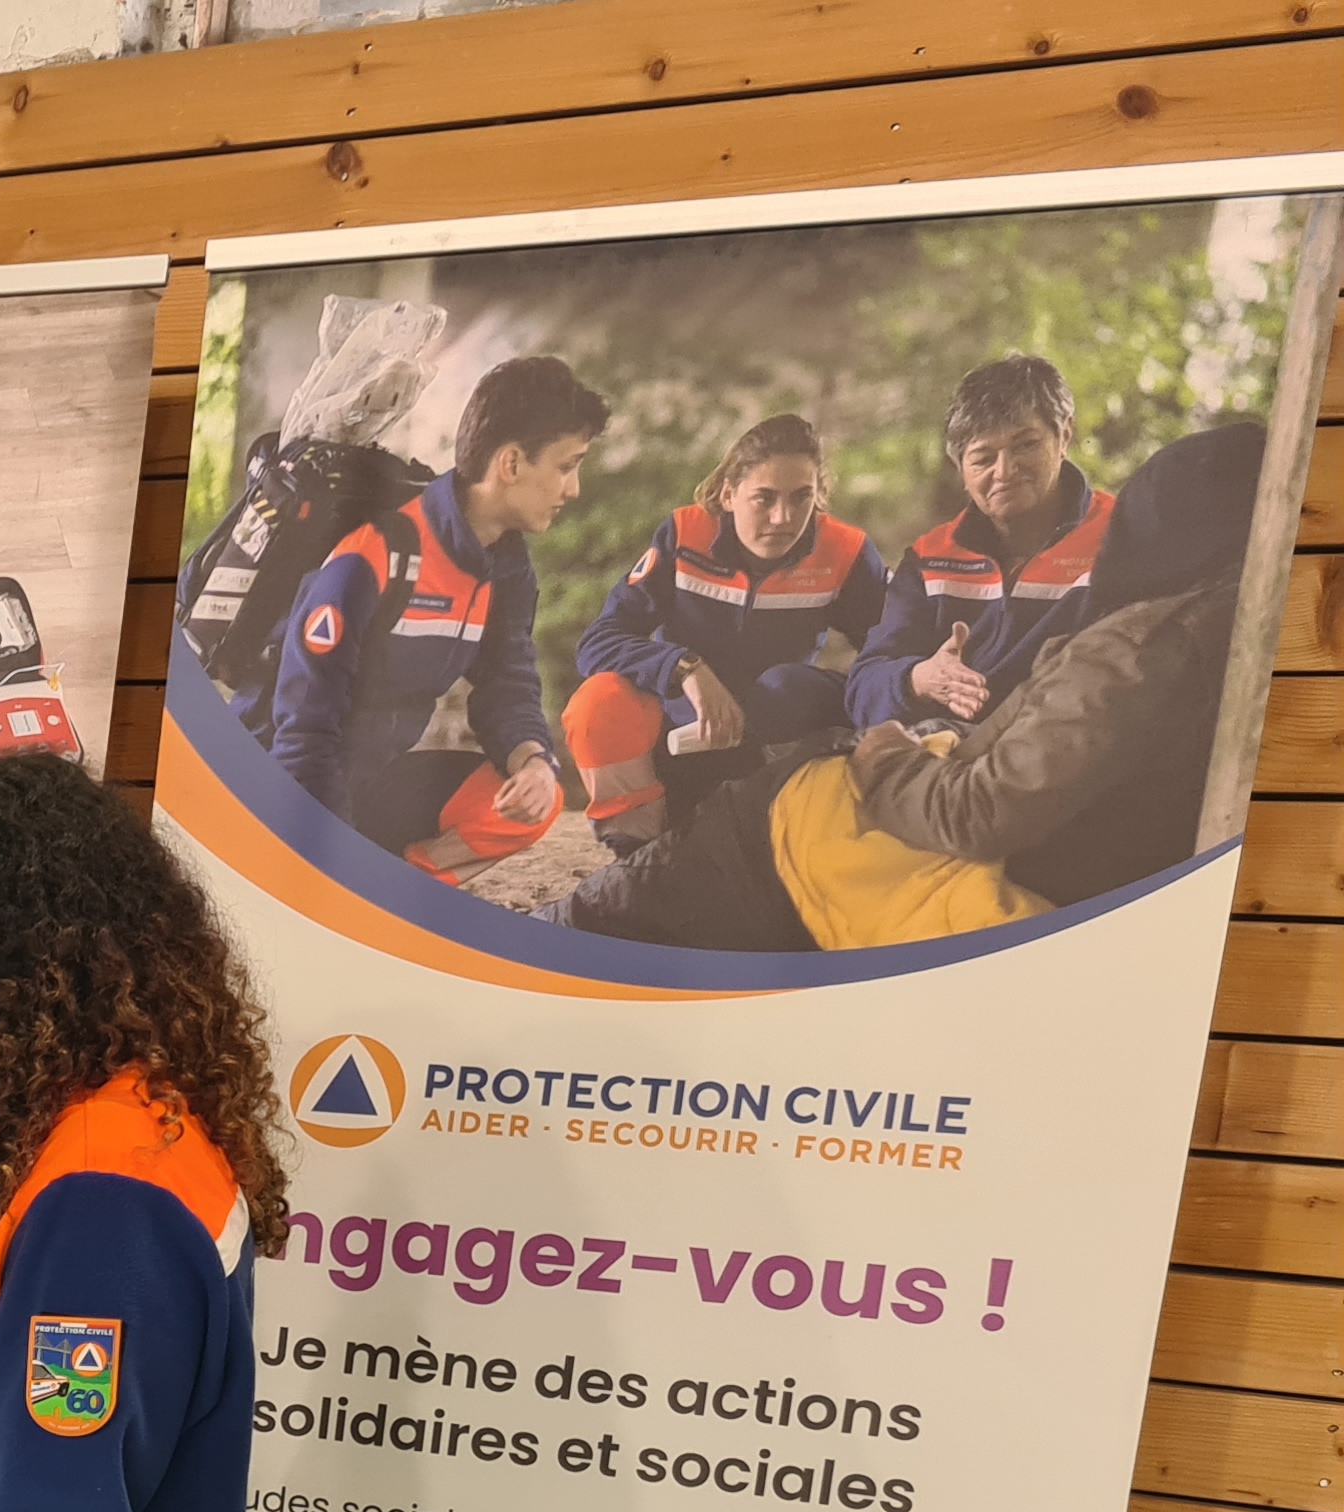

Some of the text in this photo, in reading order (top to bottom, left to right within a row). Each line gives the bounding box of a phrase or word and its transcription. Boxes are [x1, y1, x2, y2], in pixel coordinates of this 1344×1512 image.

[424, 1064, 971, 1135] PROTECTION CIVILE
[421, 1109, 963, 1170] AIDER SECOURIR FORMER
[35, 1325, 114, 1336] PROTECTION CIVILE
[66, 1388, 105, 1414] 60
[260, 1327, 921, 1441] Je mène des actions
[253, 1396, 539, 1466] solidaires
[557, 1434, 620, 1477] et
